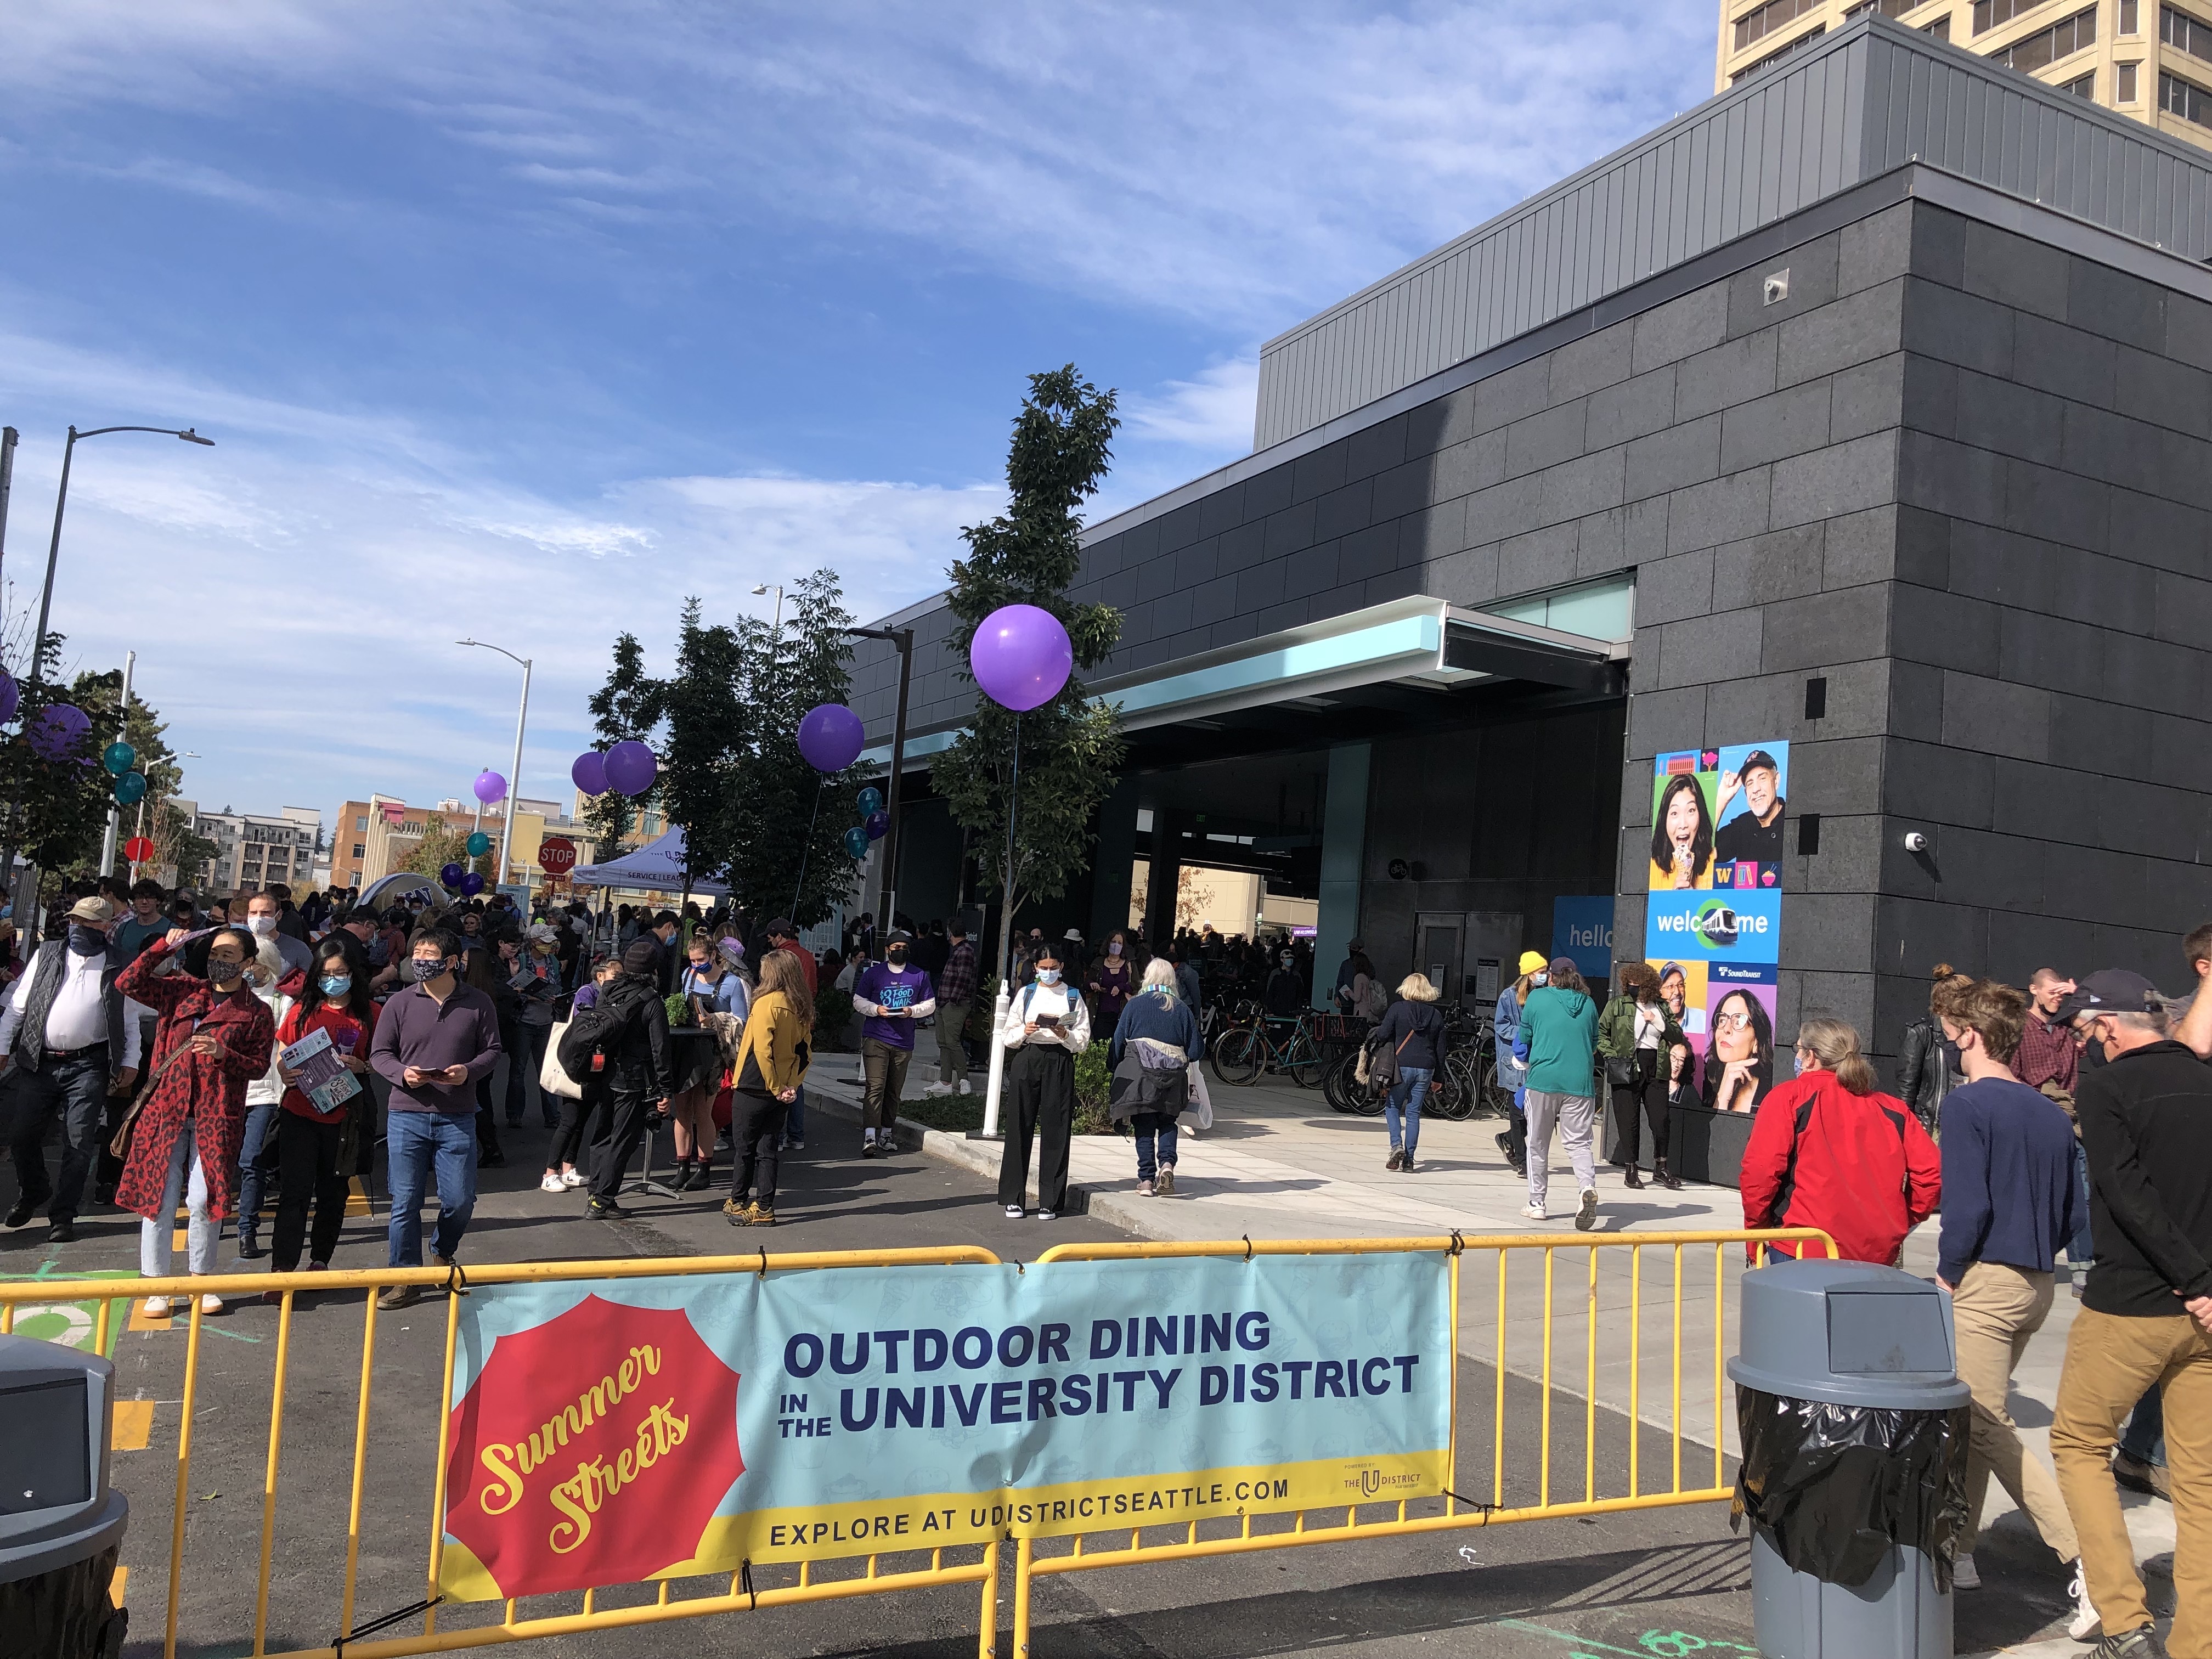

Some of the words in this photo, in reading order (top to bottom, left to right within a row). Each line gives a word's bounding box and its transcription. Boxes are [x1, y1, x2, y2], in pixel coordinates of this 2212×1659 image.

[1196, 814, 1206, 822] EXIT
[540, 848, 574, 864] STOP
[628, 872, 657, 881] SERVICE
[1716, 868, 1732, 883] W
[879, 989, 892, 1006] $3
[893, 988, 914, 998] FOOD
[893, 997, 912, 1007] WALK
[784, 1323, 1071, 1378] OUTDOOR
[1090, 1311, 1270, 1359] DINING
[780, 1393, 808, 1414] IN
[840, 1369, 1183, 1432] UNIVERSITY
[1200, 1355, 1419, 1406] DISTRICT
[481, 1344, 661, 1515] Summer
[777, 1417, 832, 1438] THE
[549, 1397, 689, 1554] Streets
[1344, 1479, 1360, 1488] THE
[1362, 1470, 1380, 1498] U
[1381, 1474, 1421, 1485] DISTRICT
[770, 1513, 910, 1546] EXPLORE
[922, 1509, 956, 1532] AT
[970, 1479, 1288, 1527] UDISTRICTSEATTLE.COM
